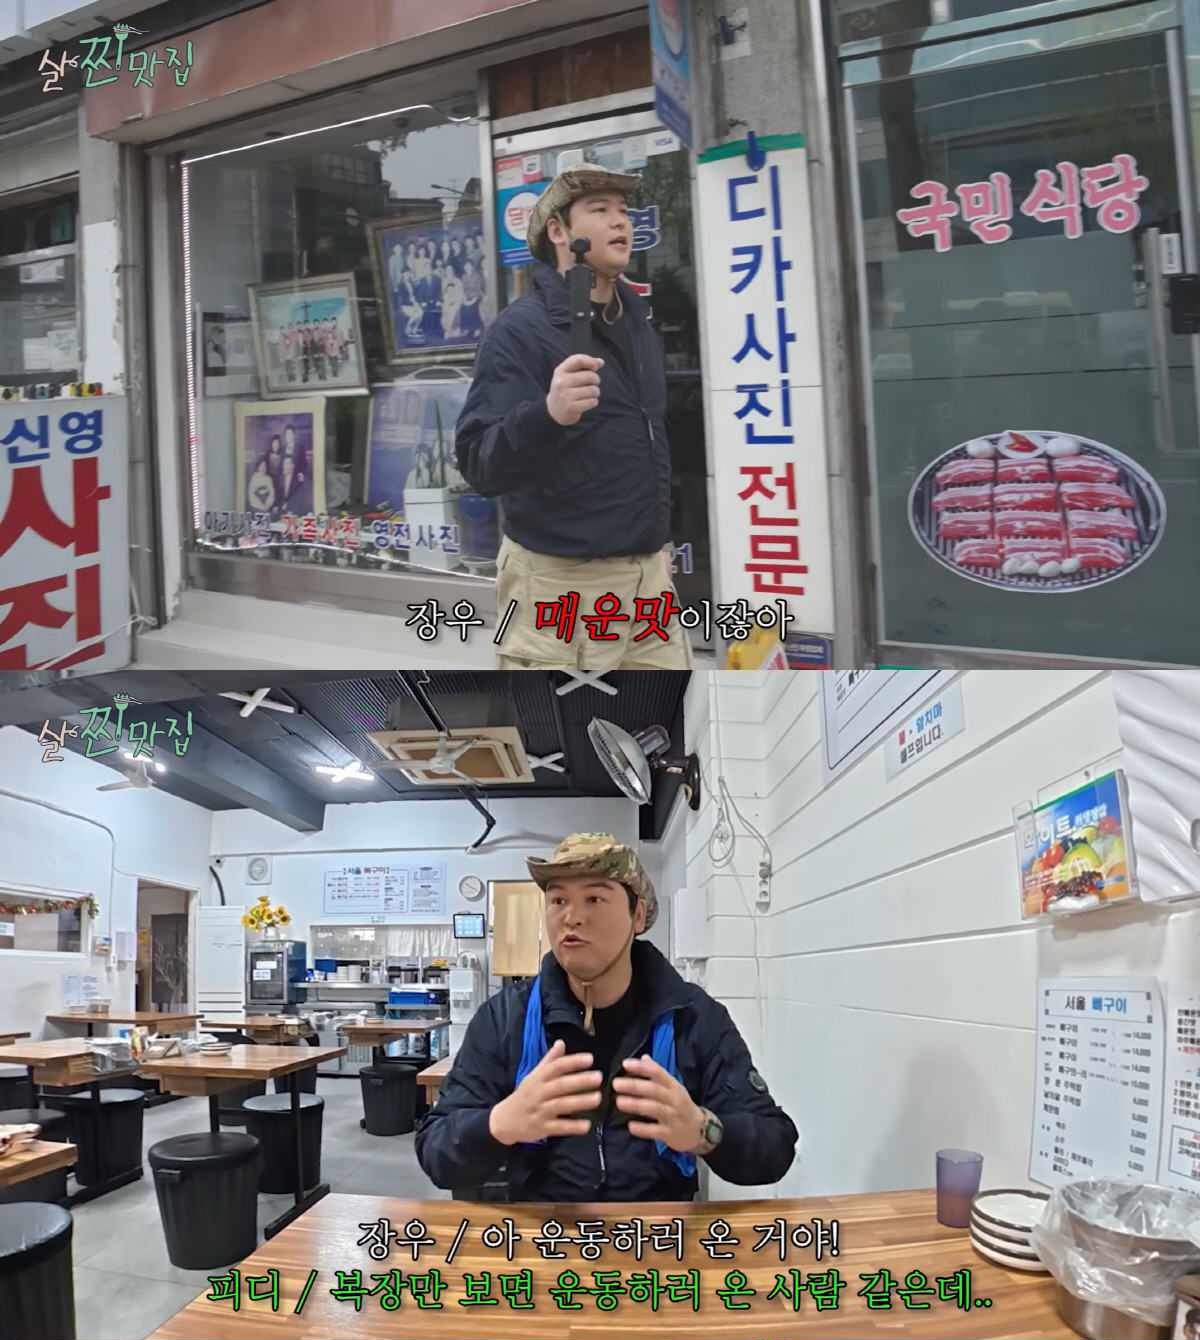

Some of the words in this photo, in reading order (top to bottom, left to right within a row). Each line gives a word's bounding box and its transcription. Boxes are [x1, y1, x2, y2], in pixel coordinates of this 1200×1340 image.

[654, 136, 673, 147] VISA
[0, 409, 103, 464] 신영
[282, 514, 360, 547] 가족사진
[737, 462, 808, 597] 전문
[0, 456, 111, 669] 사진
[1065, 995, 1087, 1011] 서울
